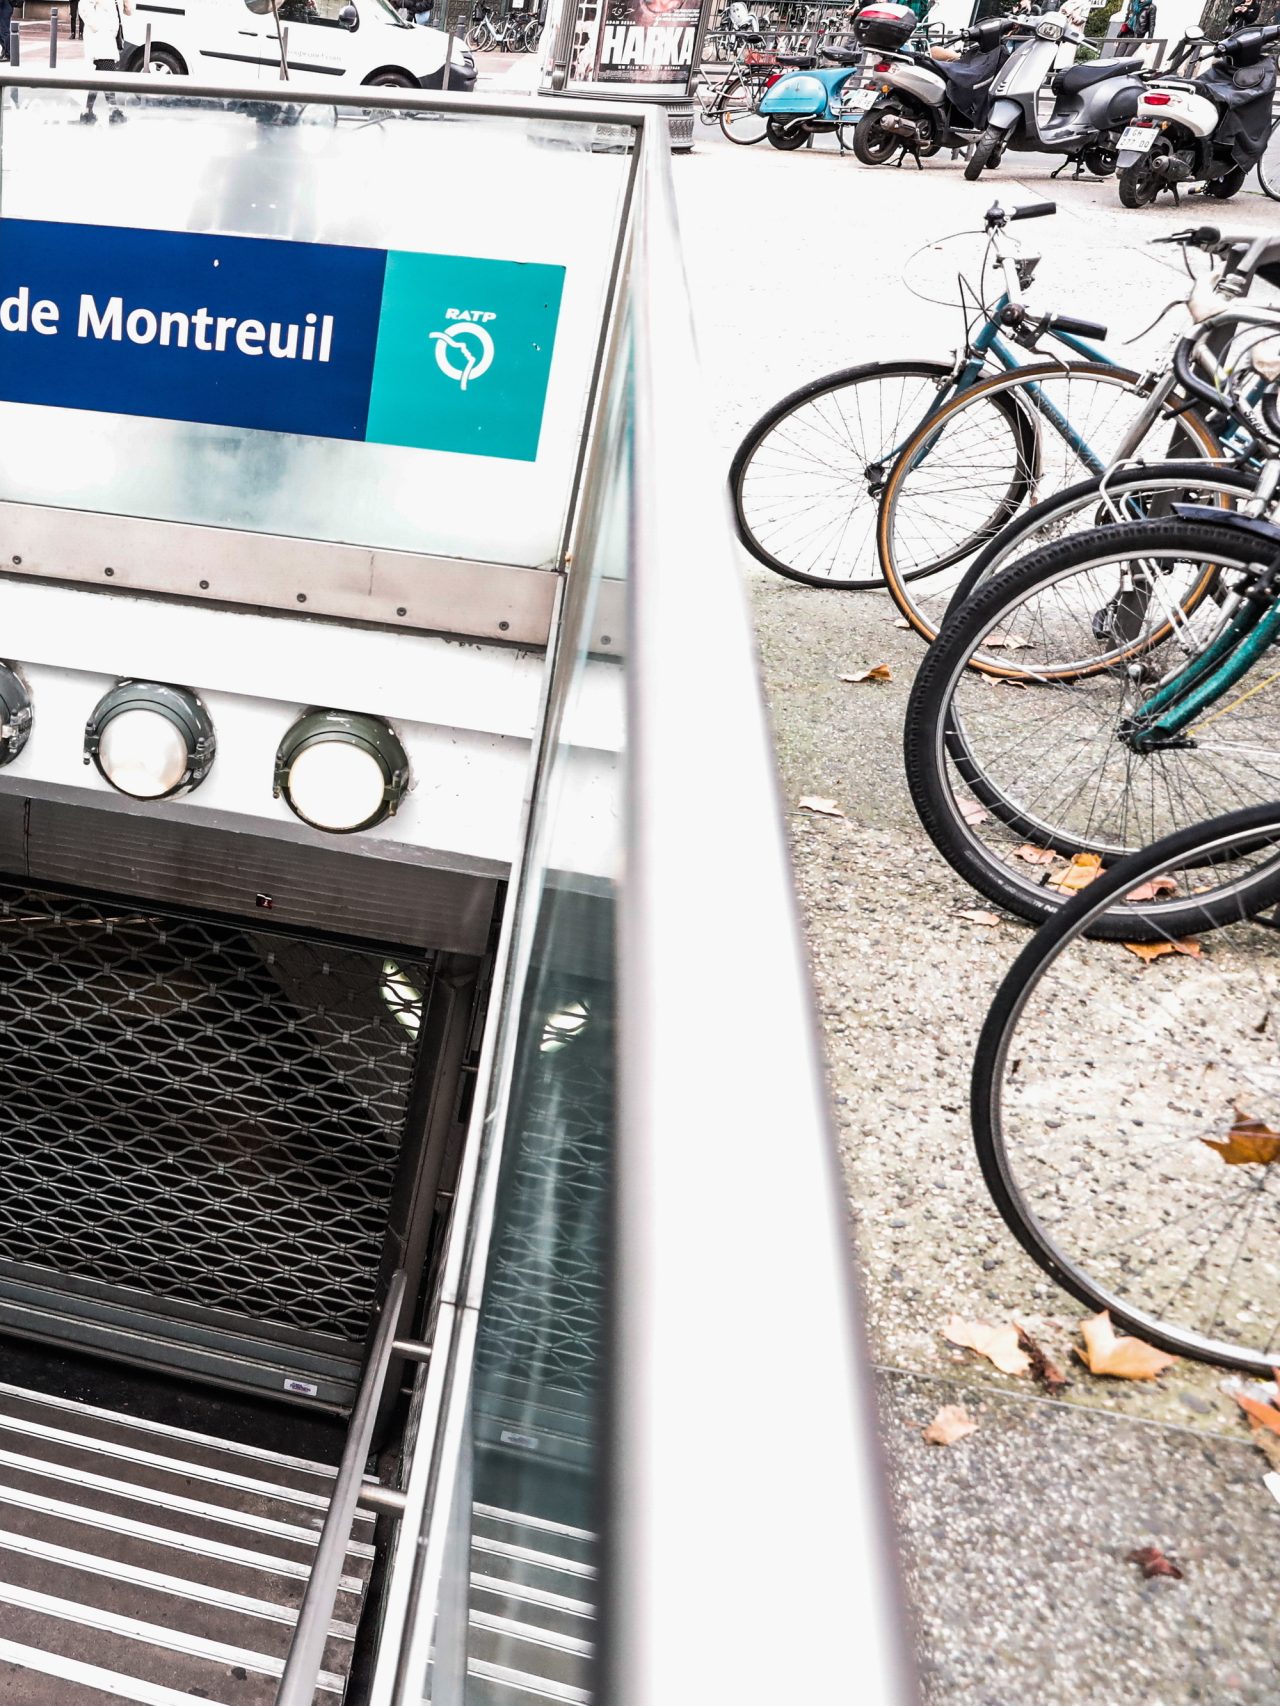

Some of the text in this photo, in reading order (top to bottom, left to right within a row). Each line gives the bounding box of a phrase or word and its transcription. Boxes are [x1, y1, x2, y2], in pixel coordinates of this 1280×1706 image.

[600, 25, 696, 65] HARKA
[0, 286, 60, 335] de
[77, 294, 334, 362] Montreuil
[445, 308, 497, 323] RATP
